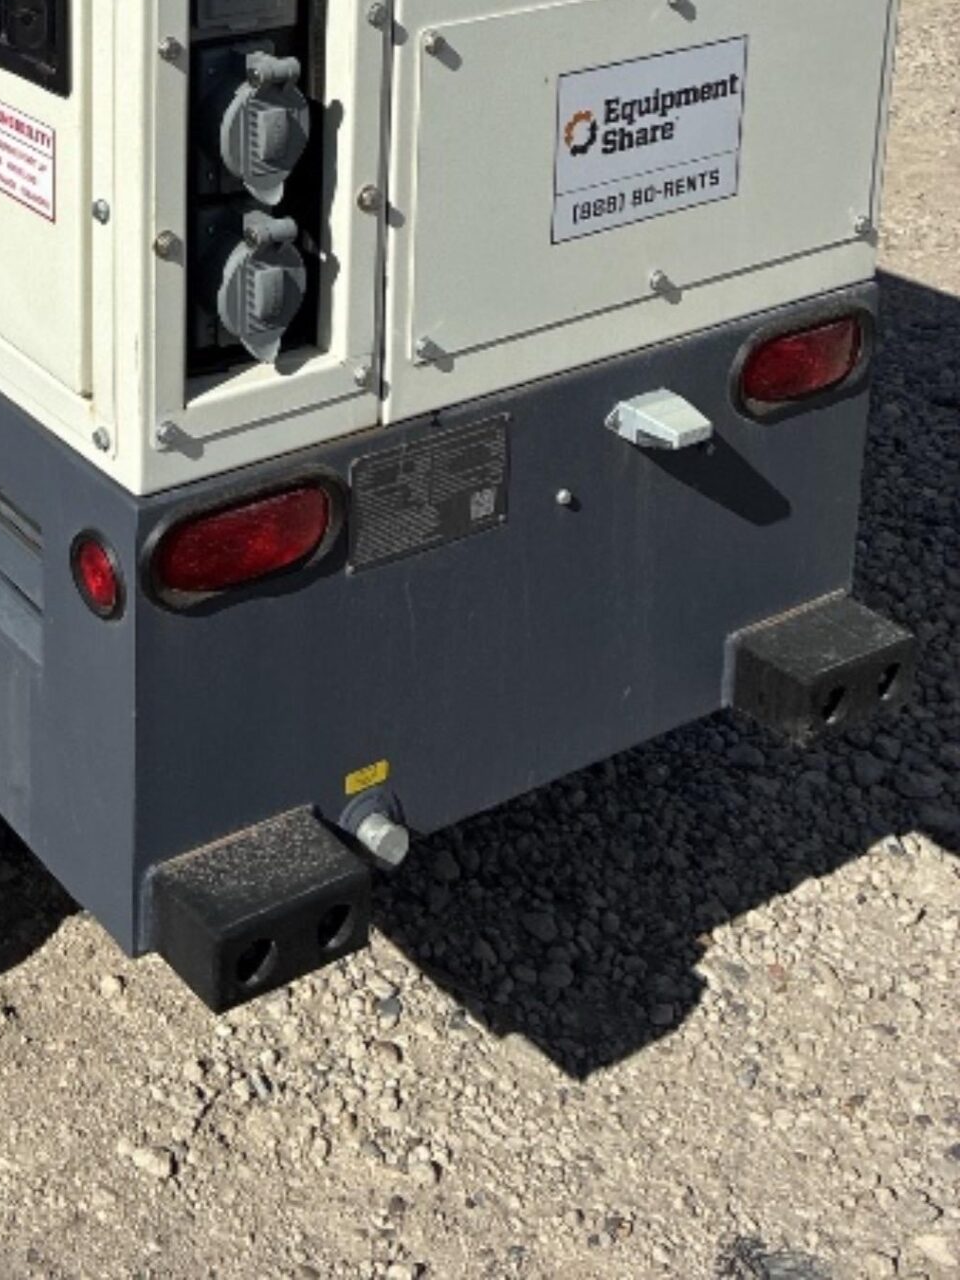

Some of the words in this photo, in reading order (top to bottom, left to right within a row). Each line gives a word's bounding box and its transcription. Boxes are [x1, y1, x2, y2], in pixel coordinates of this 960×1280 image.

[603, 73, 740, 125] Equipment
[600, 120, 675, 155] Share
[572, 193, 626, 225] (888)
[631, 167, 721, 207] 80-RENTS
